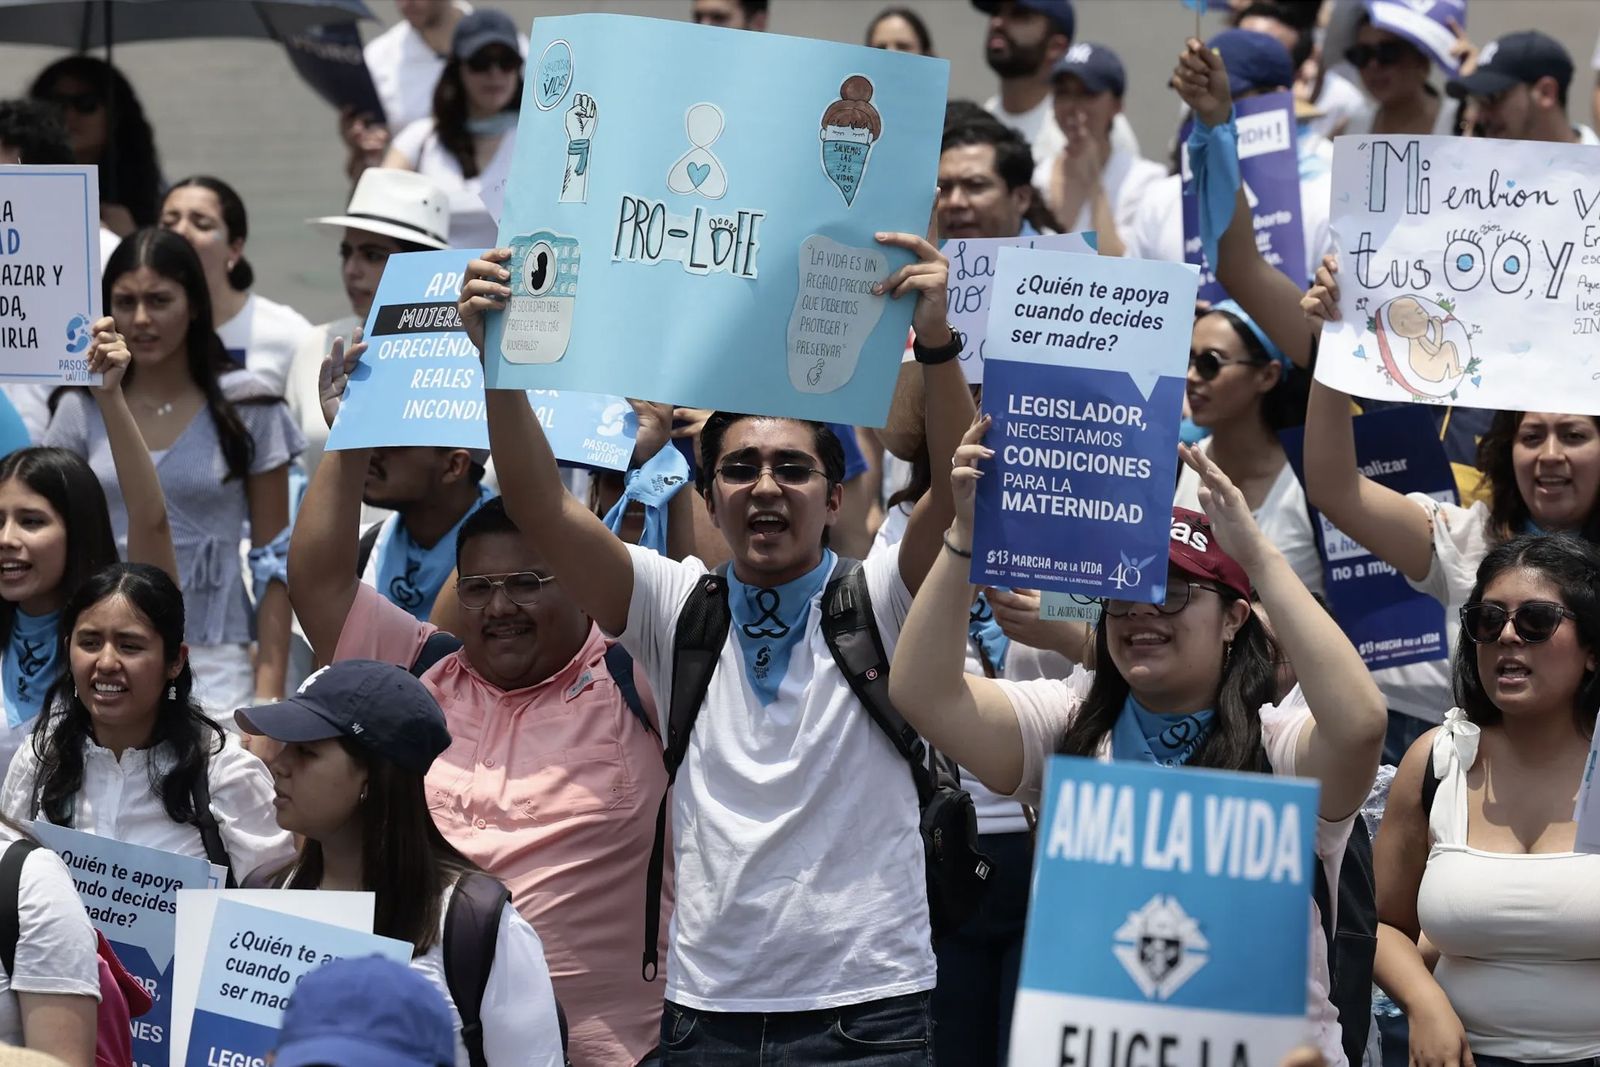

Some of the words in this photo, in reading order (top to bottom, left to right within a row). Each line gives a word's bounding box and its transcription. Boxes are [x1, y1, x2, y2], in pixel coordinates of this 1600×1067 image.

[834, 142, 862, 155] SALVEMOS
[840, 153, 852, 162] LAS
[836, 173, 854, 184] VIDAS
[826, 252, 848, 269] VIDA
[850, 255, 862, 271] ES
[864, 258, 878, 273] UN
[953, 241, 995, 280] La
[1350, 232, 1431, 290] tus
[53, 265, 63, 286] Y
[805, 272, 838, 291] REGALO
[1017, 274, 1083, 298] ¿Quién
[1089, 280, 1107, 299] te
[1112, 286, 1169, 308] apoya
[801, 295, 818, 310] QUE
[820, 297, 859, 315] DEBEMOS
[799, 316, 841, 335] PROTEGER
[843, 322, 849, 336] Y
[1014, 302, 1083, 323] cuando
[1090, 306, 1164, 331] decides
[1011, 328, 1042, 345] ser
[1046, 331, 1118, 352] madre?
[58, 359, 89, 371] PASOS
[410, 368, 475, 389] REALES
[1008, 394, 1147, 431] LEGISLADOR,
[1006, 421, 1123, 448] NECESITAMOS
[583, 438, 616, 454] PASOS
[1003, 445, 1152, 479] CONDICIONES
[1003, 472, 1047, 491] PARA
[1052, 477, 1072, 494] LA
[1001, 491, 1144, 524] MATERNIDAD
[1170, 516, 1208, 552] as
[1328, 543, 1336, 554] a
[1011, 554, 1051, 570] MARCHA
[1054, 561, 1068, 572] POR
[1070, 563, 1078, 573] LA
[1081, 561, 1103, 575] VIDA
[1332, 566, 1352, 582] no
[1355, 563, 1365, 577] a
[1034, 573, 1063, 582] MONUMENTO
[1108, 562, 1141, 590] 40
[1048, 605, 1056, 617] EL
[1077, 606, 1086, 619] NO
[1086, 607, 1093, 619] ES
[1046, 778, 1135, 866] AMA
[1142, 788, 1193, 873] LA
[1204, 794, 1303, 886] VIDA
[56, 848, 107, 876] Quién
[111, 863, 128, 880] te
[132, 870, 184, 893] apoya
[111, 886, 177, 915] decides
[230, 930, 293, 959] ¿Quién
[298, 944, 317, 964] te
[225, 956, 291, 984] cuando
[219, 982, 249, 1000] ser
